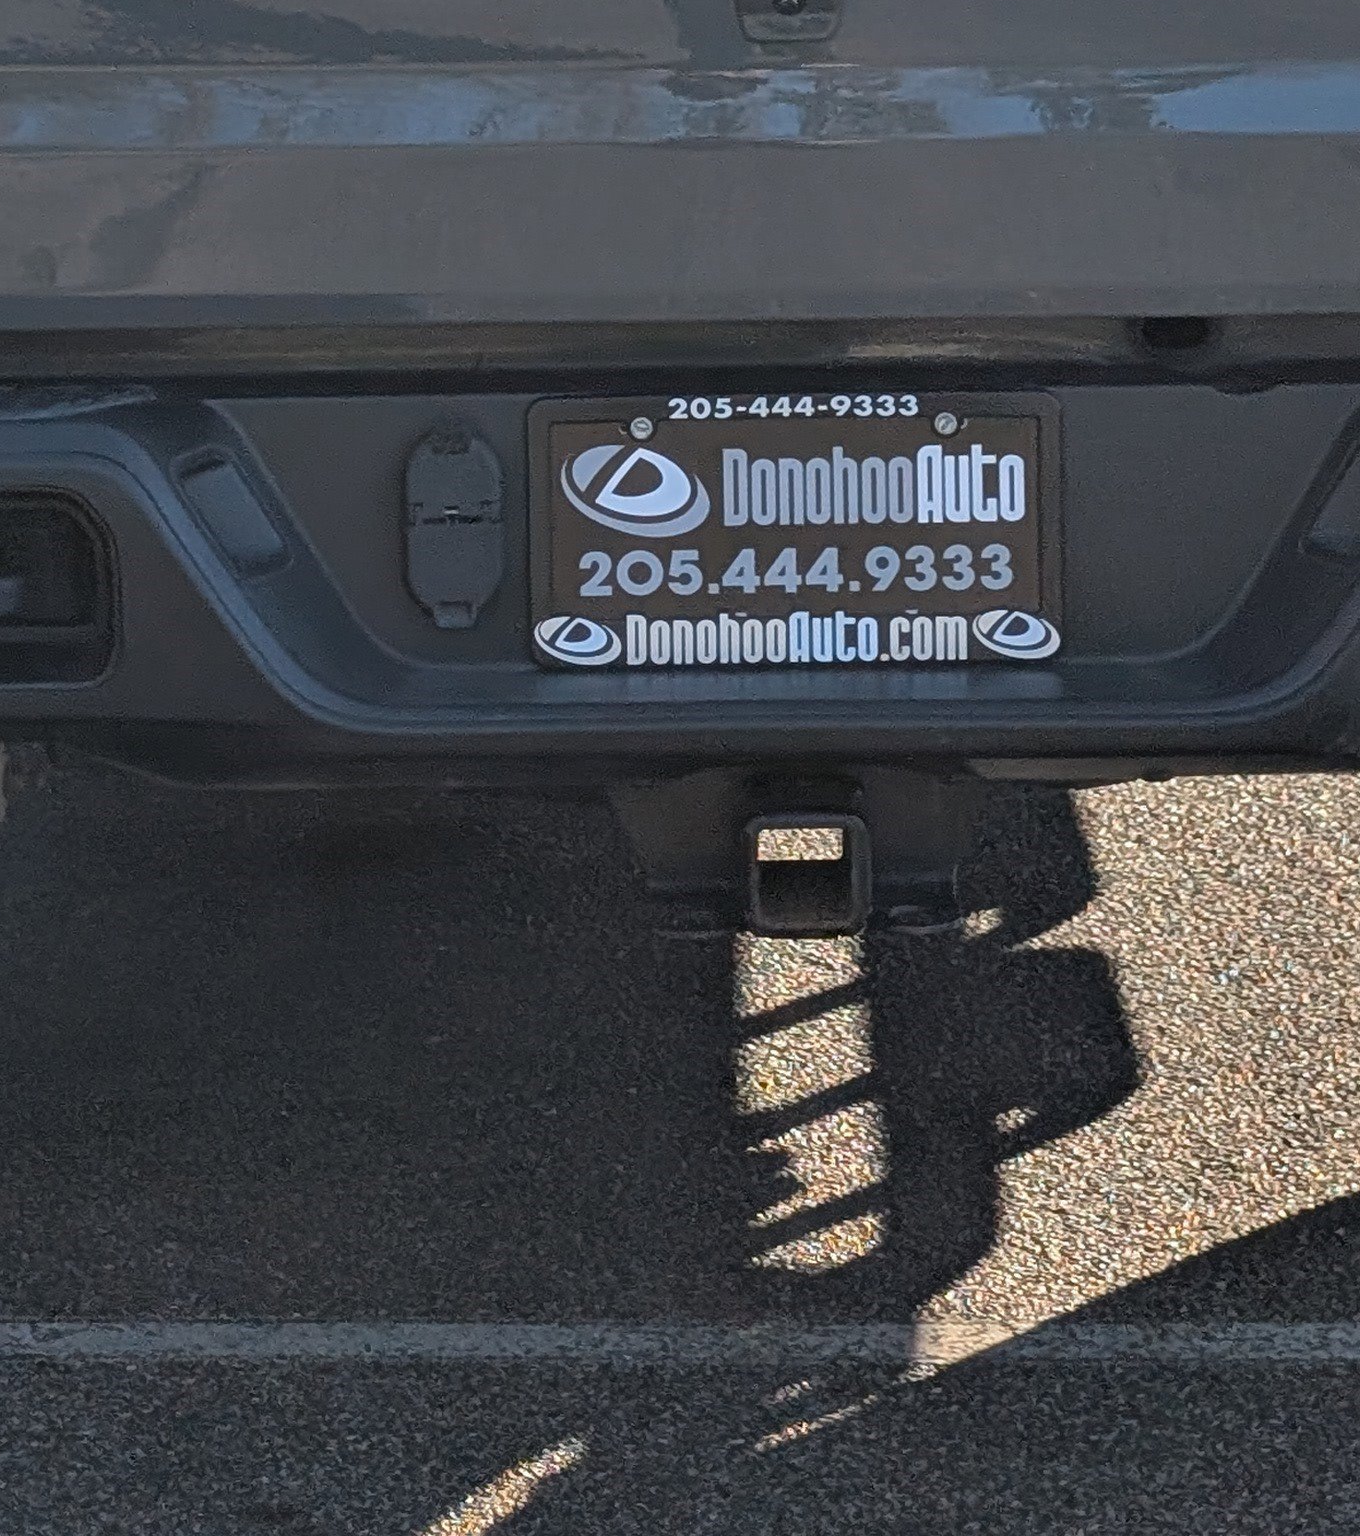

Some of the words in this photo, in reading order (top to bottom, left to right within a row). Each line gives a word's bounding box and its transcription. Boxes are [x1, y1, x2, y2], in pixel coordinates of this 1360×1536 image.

[668, 394, 920, 420] 205-444-9333
[722, 443, 1026, 526] DonohooAuto
[578, 544, 1016, 597] 205.444.9333
[626, 610, 969, 665] DonohooAuto.com
